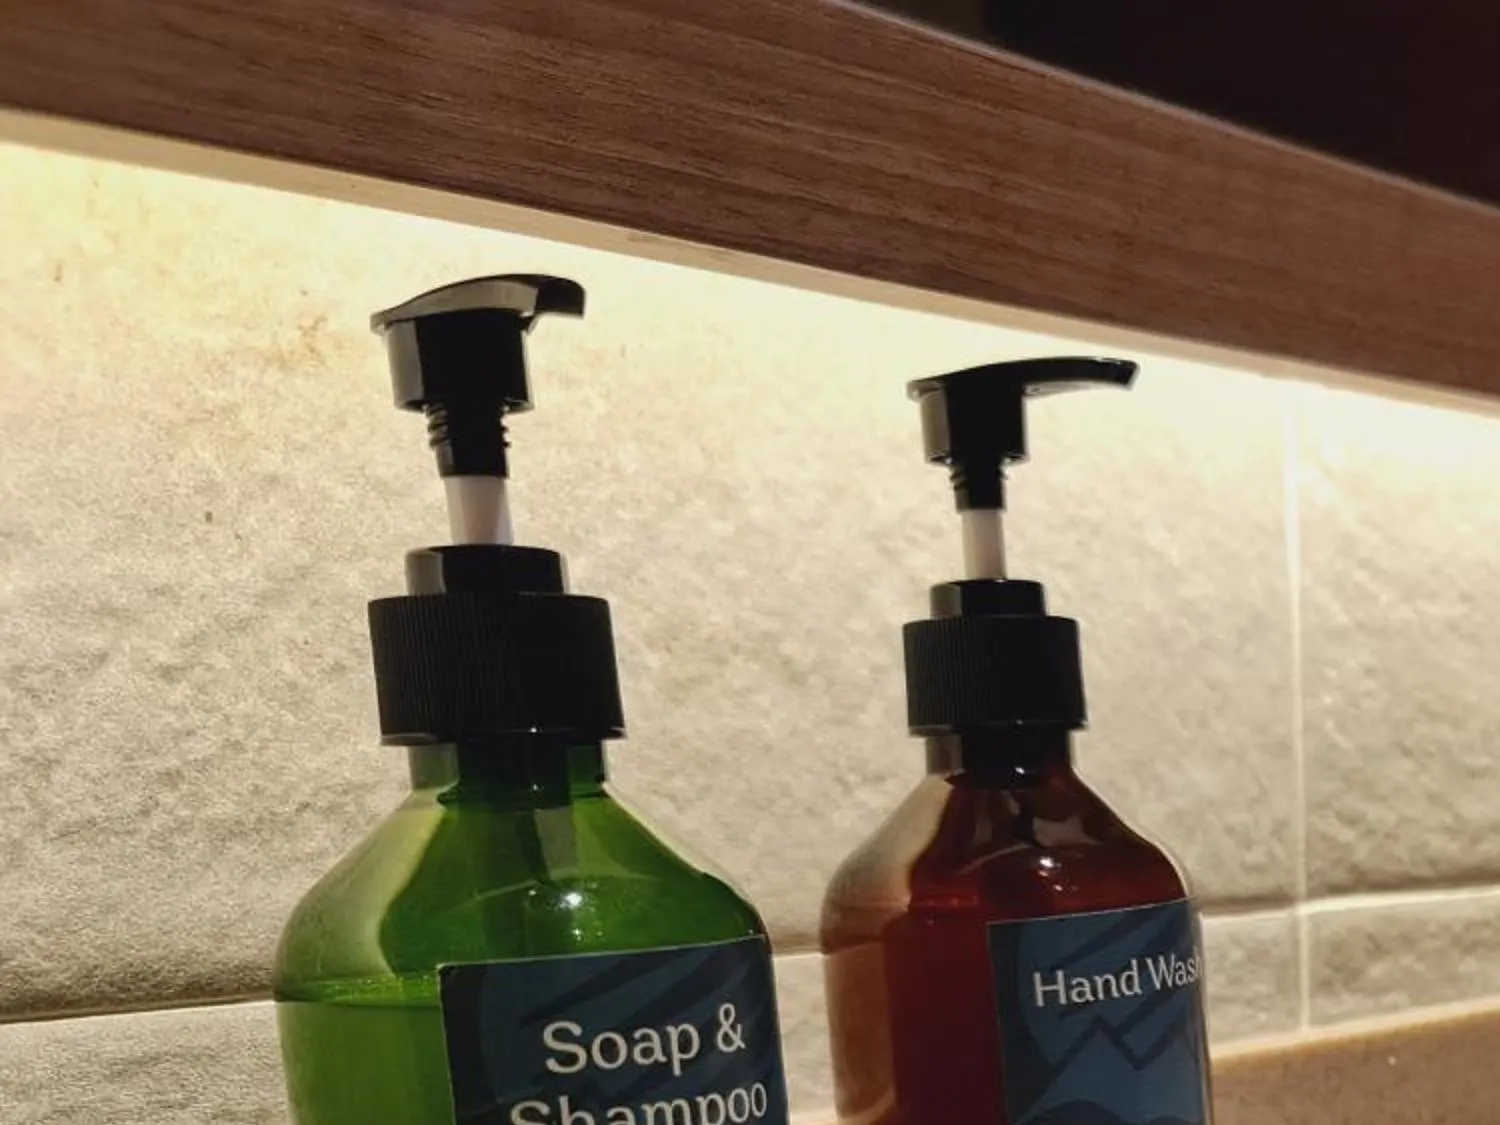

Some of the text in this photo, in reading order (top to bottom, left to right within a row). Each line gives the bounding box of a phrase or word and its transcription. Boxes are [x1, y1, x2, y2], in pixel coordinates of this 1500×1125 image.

[1033, 958, 1142, 1007] Hand
[542, 1002, 747, 1077] Soap &
